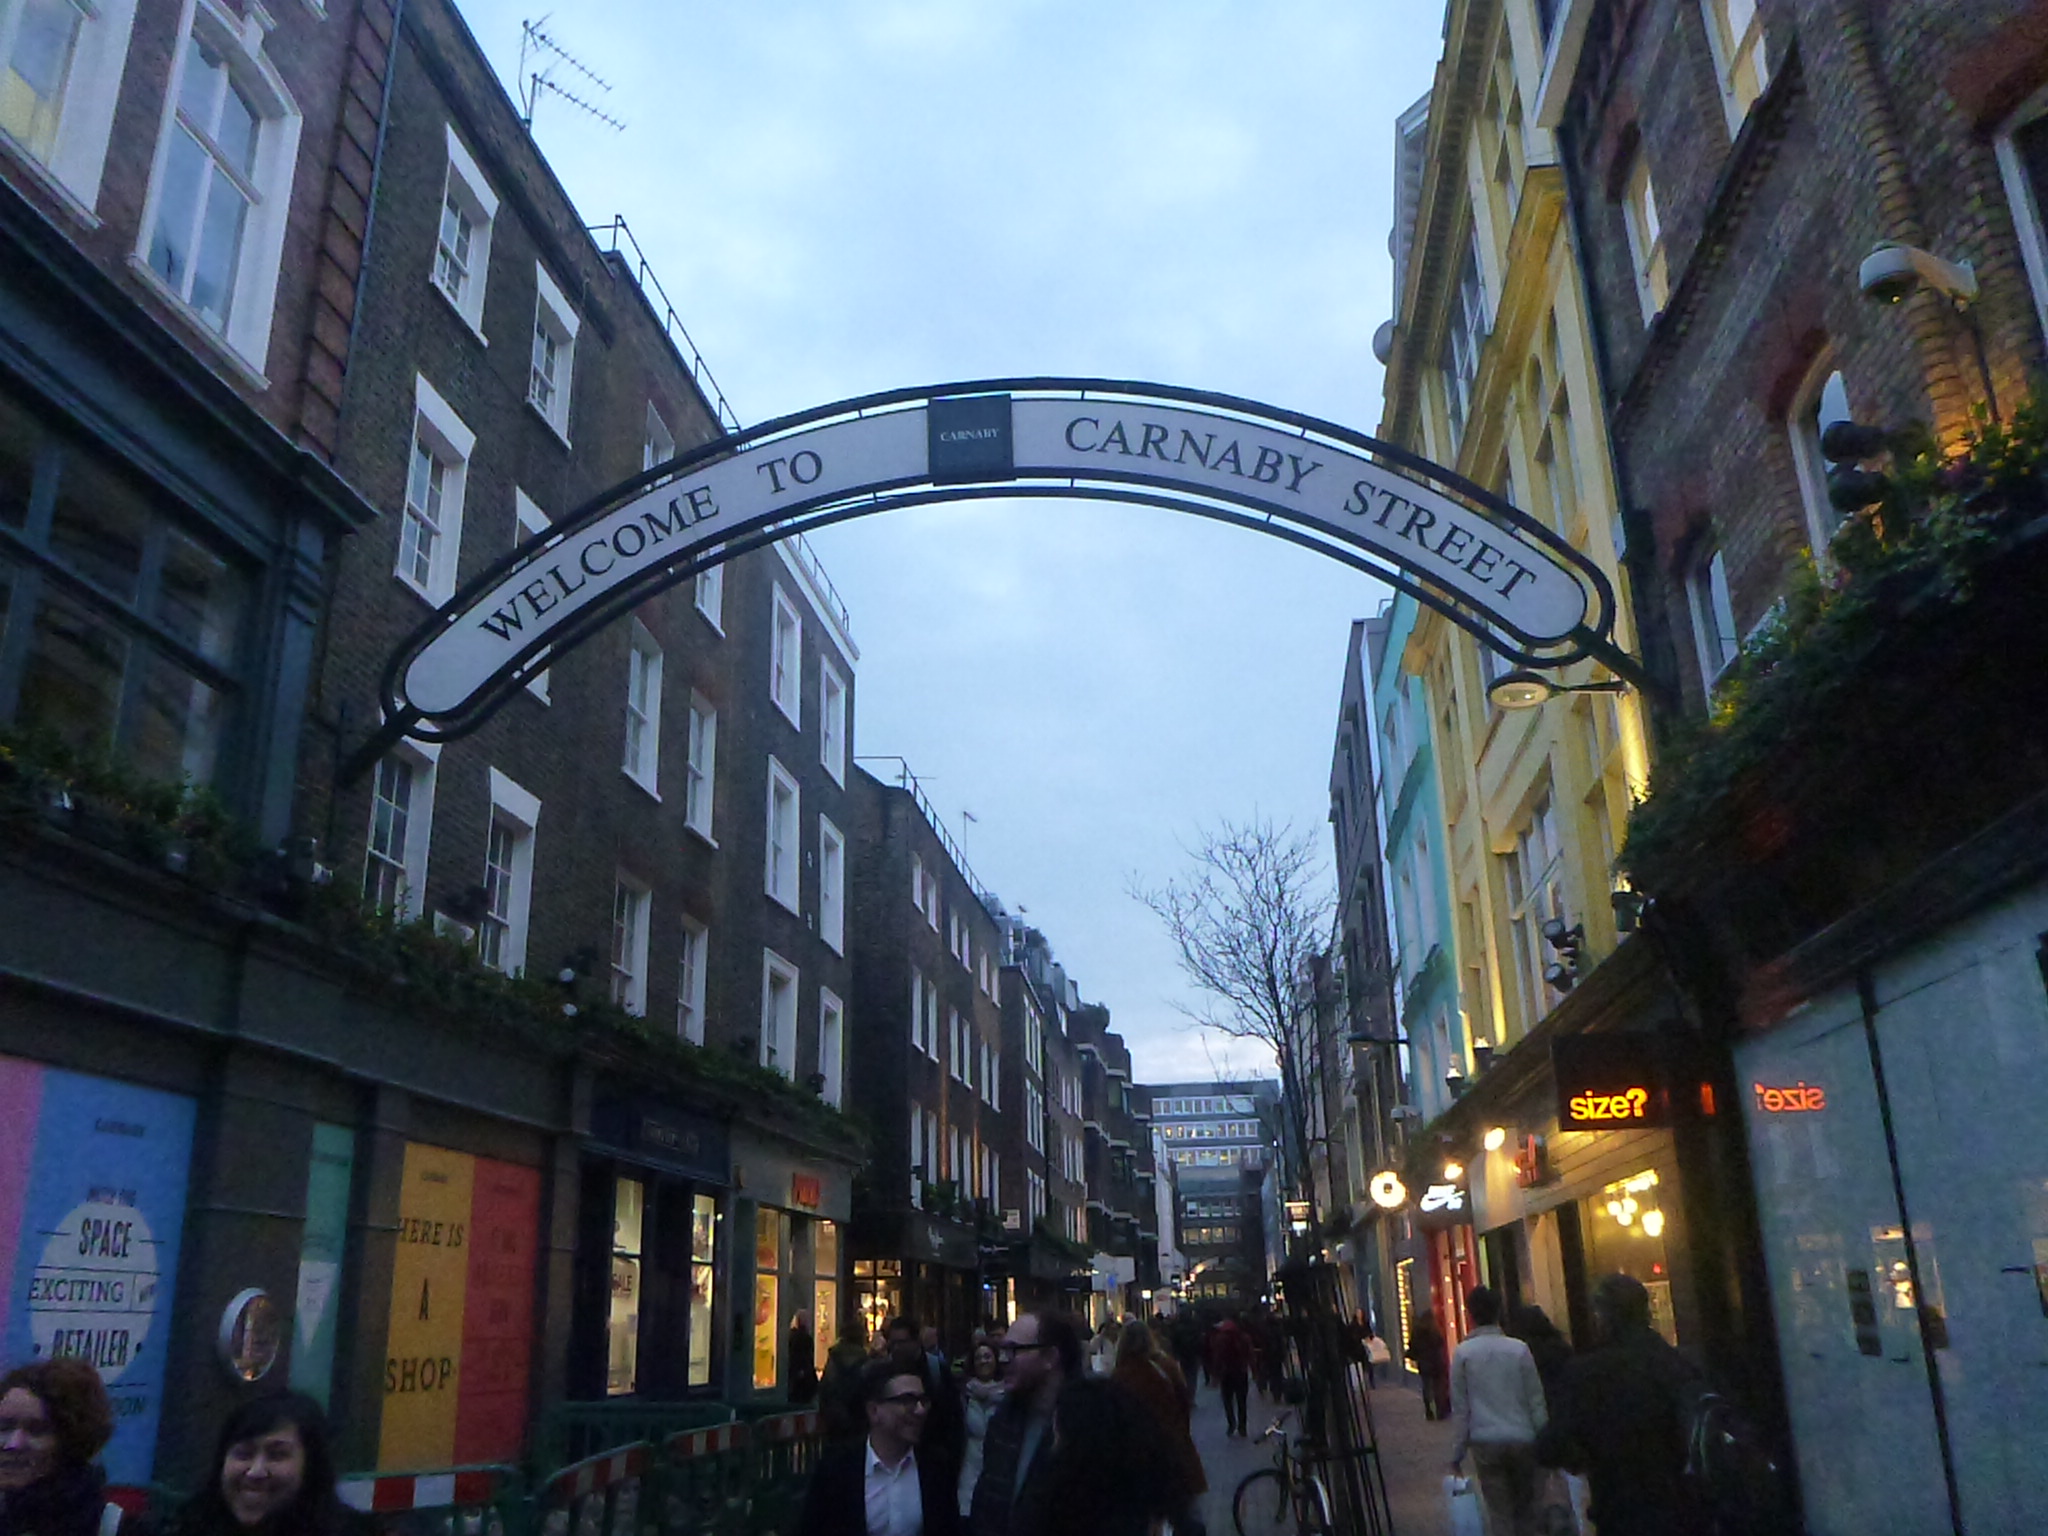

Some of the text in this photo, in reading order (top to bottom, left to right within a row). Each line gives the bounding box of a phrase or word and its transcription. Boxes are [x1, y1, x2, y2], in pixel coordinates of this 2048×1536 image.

[940, 428, 998, 442] CARNABY
[1065, 416, 1536, 601] CARNABY STREET
[479, 449, 823, 643] WELCOME TO
[1570, 1087, 1648, 1120] size?
[79, 1217, 133, 1258] SPACE
[447, 1224, 464, 1247] IS
[29, 1278, 124, 1303] EXCITING
[418, 1278, 429, 1320] A
[52, 1328, 130, 1367] RETAILER
[385, 1357, 451, 1392] SHOP
